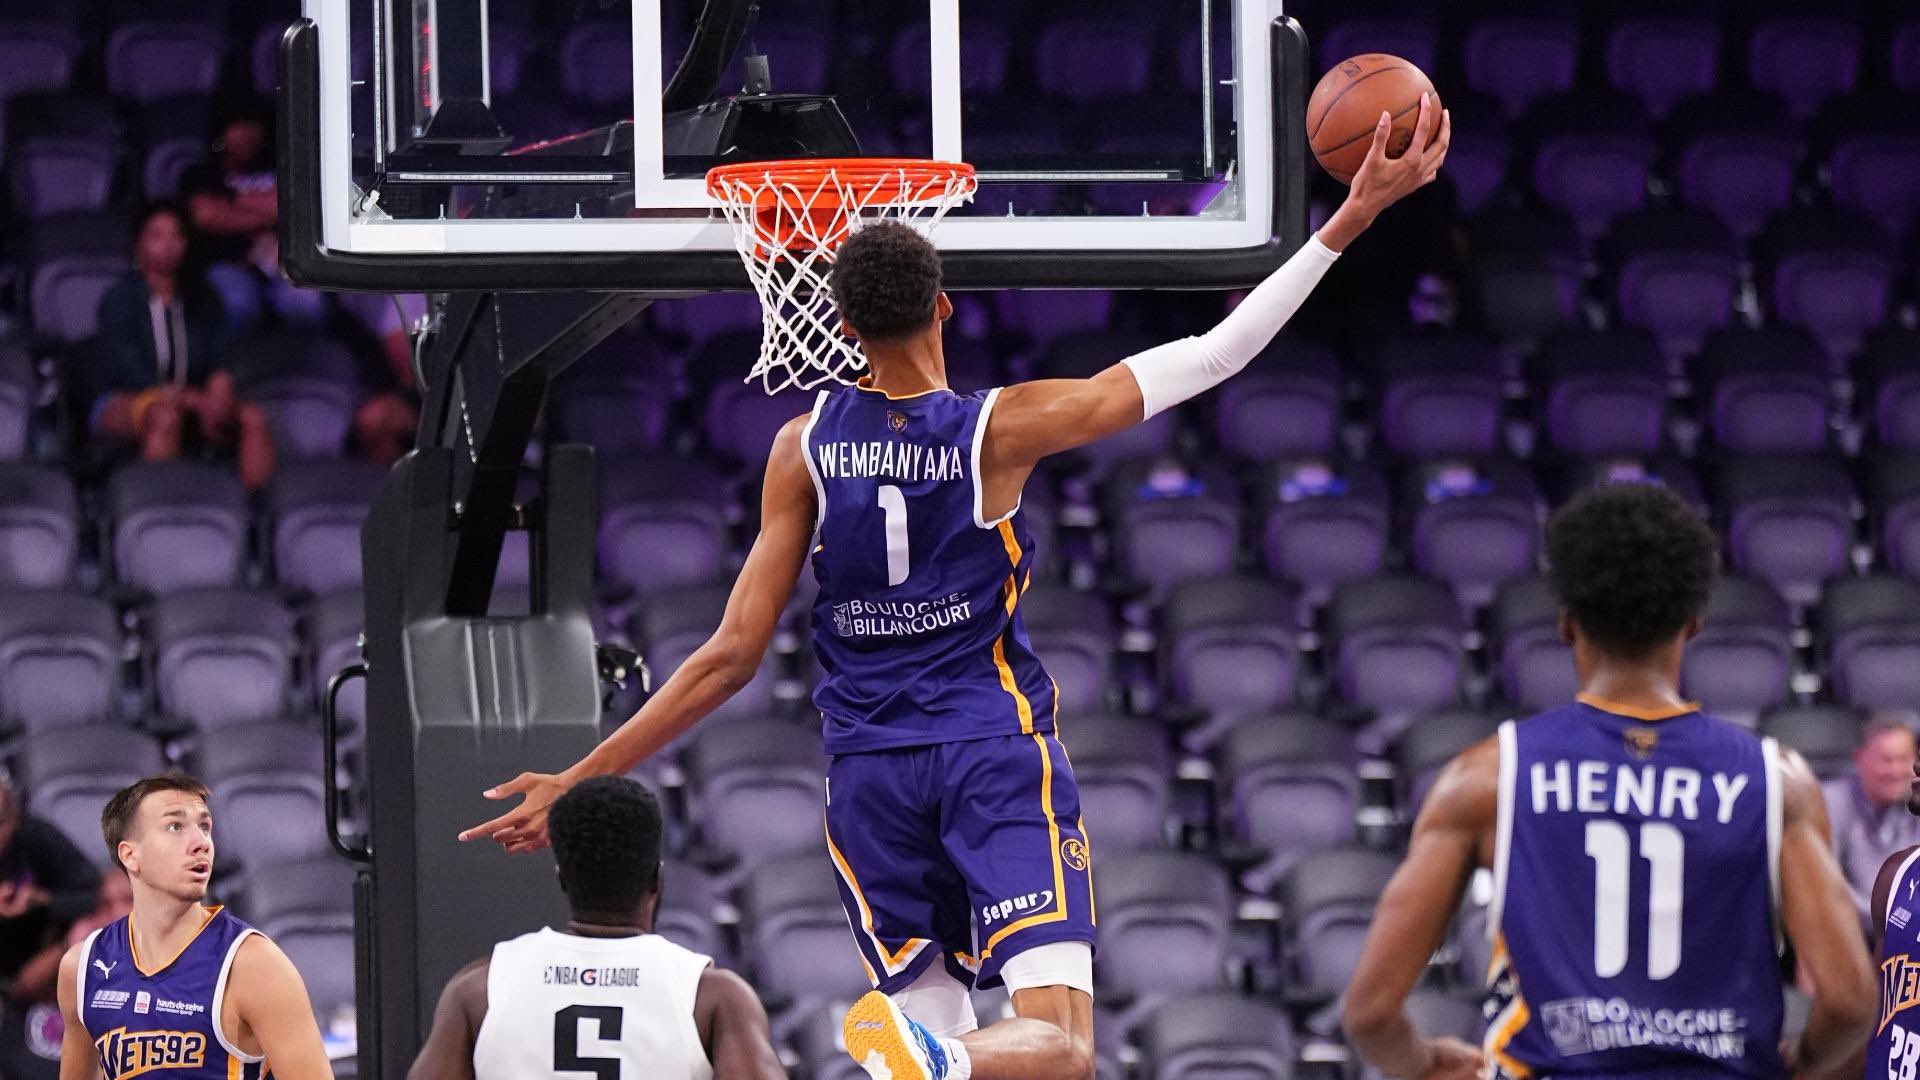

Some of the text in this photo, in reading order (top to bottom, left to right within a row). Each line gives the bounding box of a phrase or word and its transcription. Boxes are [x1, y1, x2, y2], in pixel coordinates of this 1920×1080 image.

[877, 484, 910, 587] 1
[853, 601, 971, 636] BILLANCOURT
[1530, 760, 1749, 824] HENRY
[1585, 819, 1685, 981] 11
[554, 965, 578, 986] NBA
[599, 967, 640, 987] LEAGUE
[95, 1027, 206, 1080] METS92
